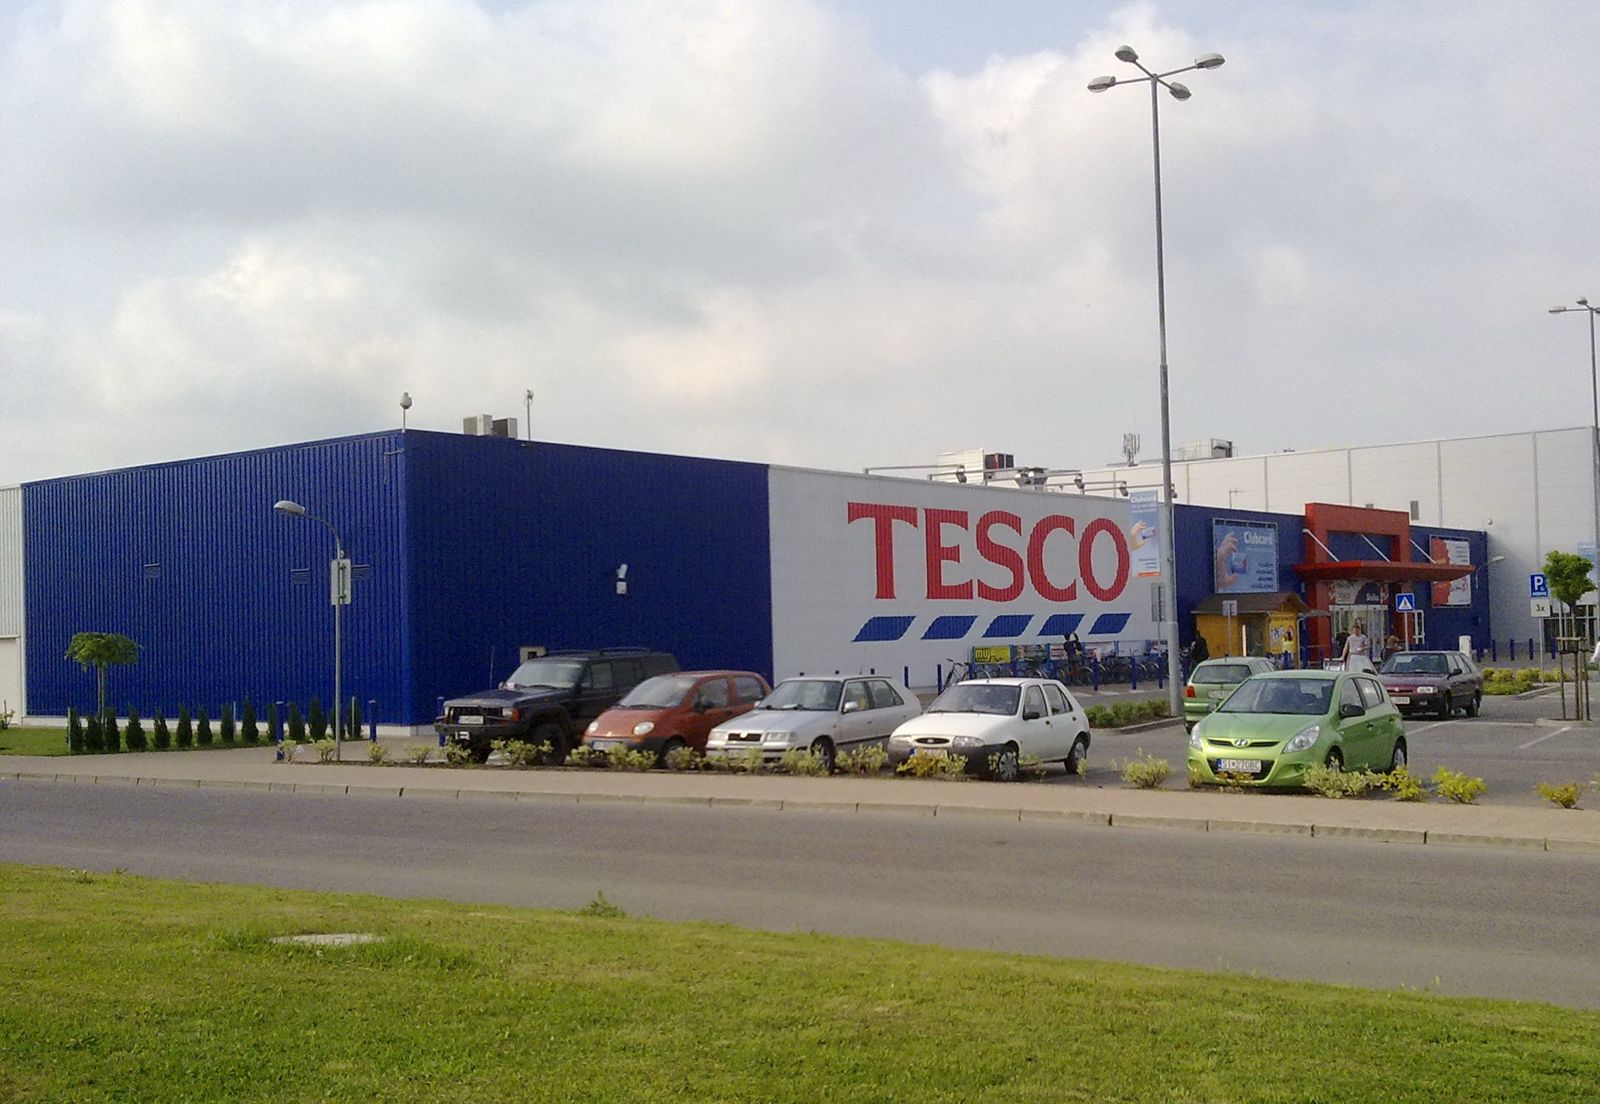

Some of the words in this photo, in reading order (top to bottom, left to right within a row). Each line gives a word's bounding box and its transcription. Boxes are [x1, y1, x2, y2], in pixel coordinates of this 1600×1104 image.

[848, 502, 1130, 602] TESCO
[1534, 576, 1544, 591] P
[1535, 604, 1545, 612] 3x
